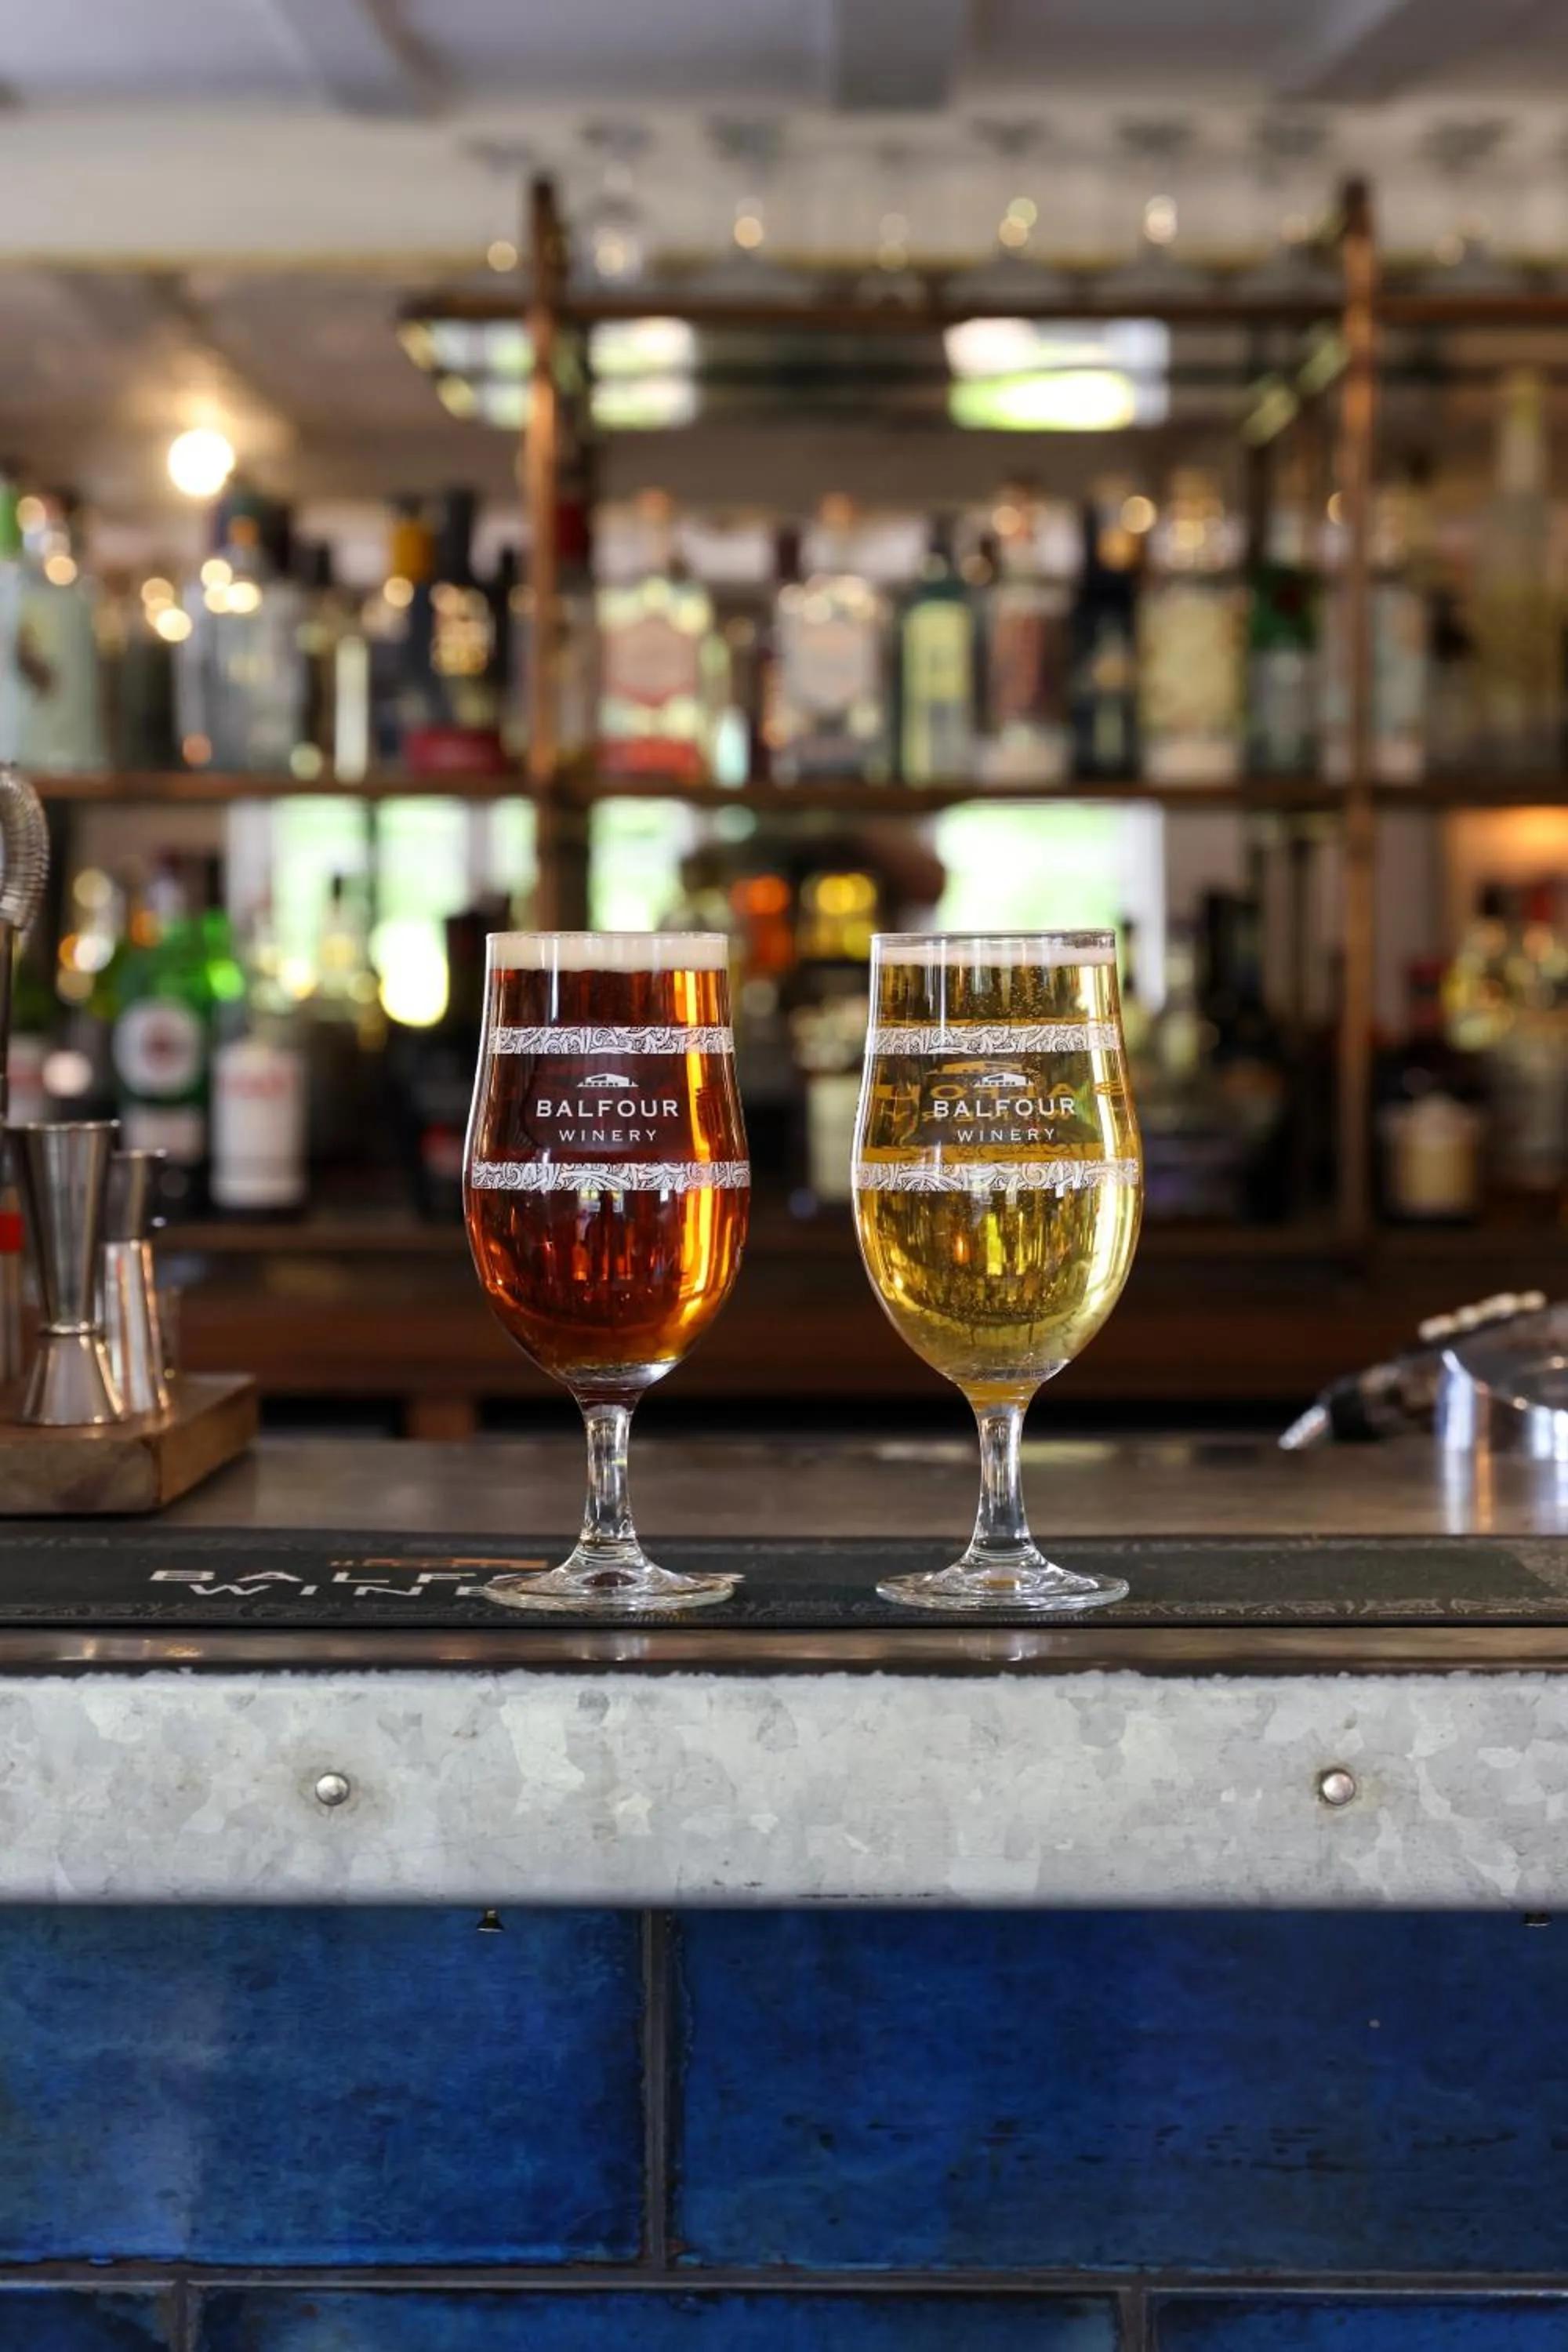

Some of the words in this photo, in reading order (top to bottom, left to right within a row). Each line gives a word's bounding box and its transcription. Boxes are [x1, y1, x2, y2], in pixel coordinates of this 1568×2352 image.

[535, 1099, 680, 1118] BALFOUR
[933, 1097, 1076, 1118] BALFOUR
[558, 1129, 658, 1142] WINERY
[956, 1127, 1054, 1142] WINERY
[189, 1584, 485, 1596] WINE
